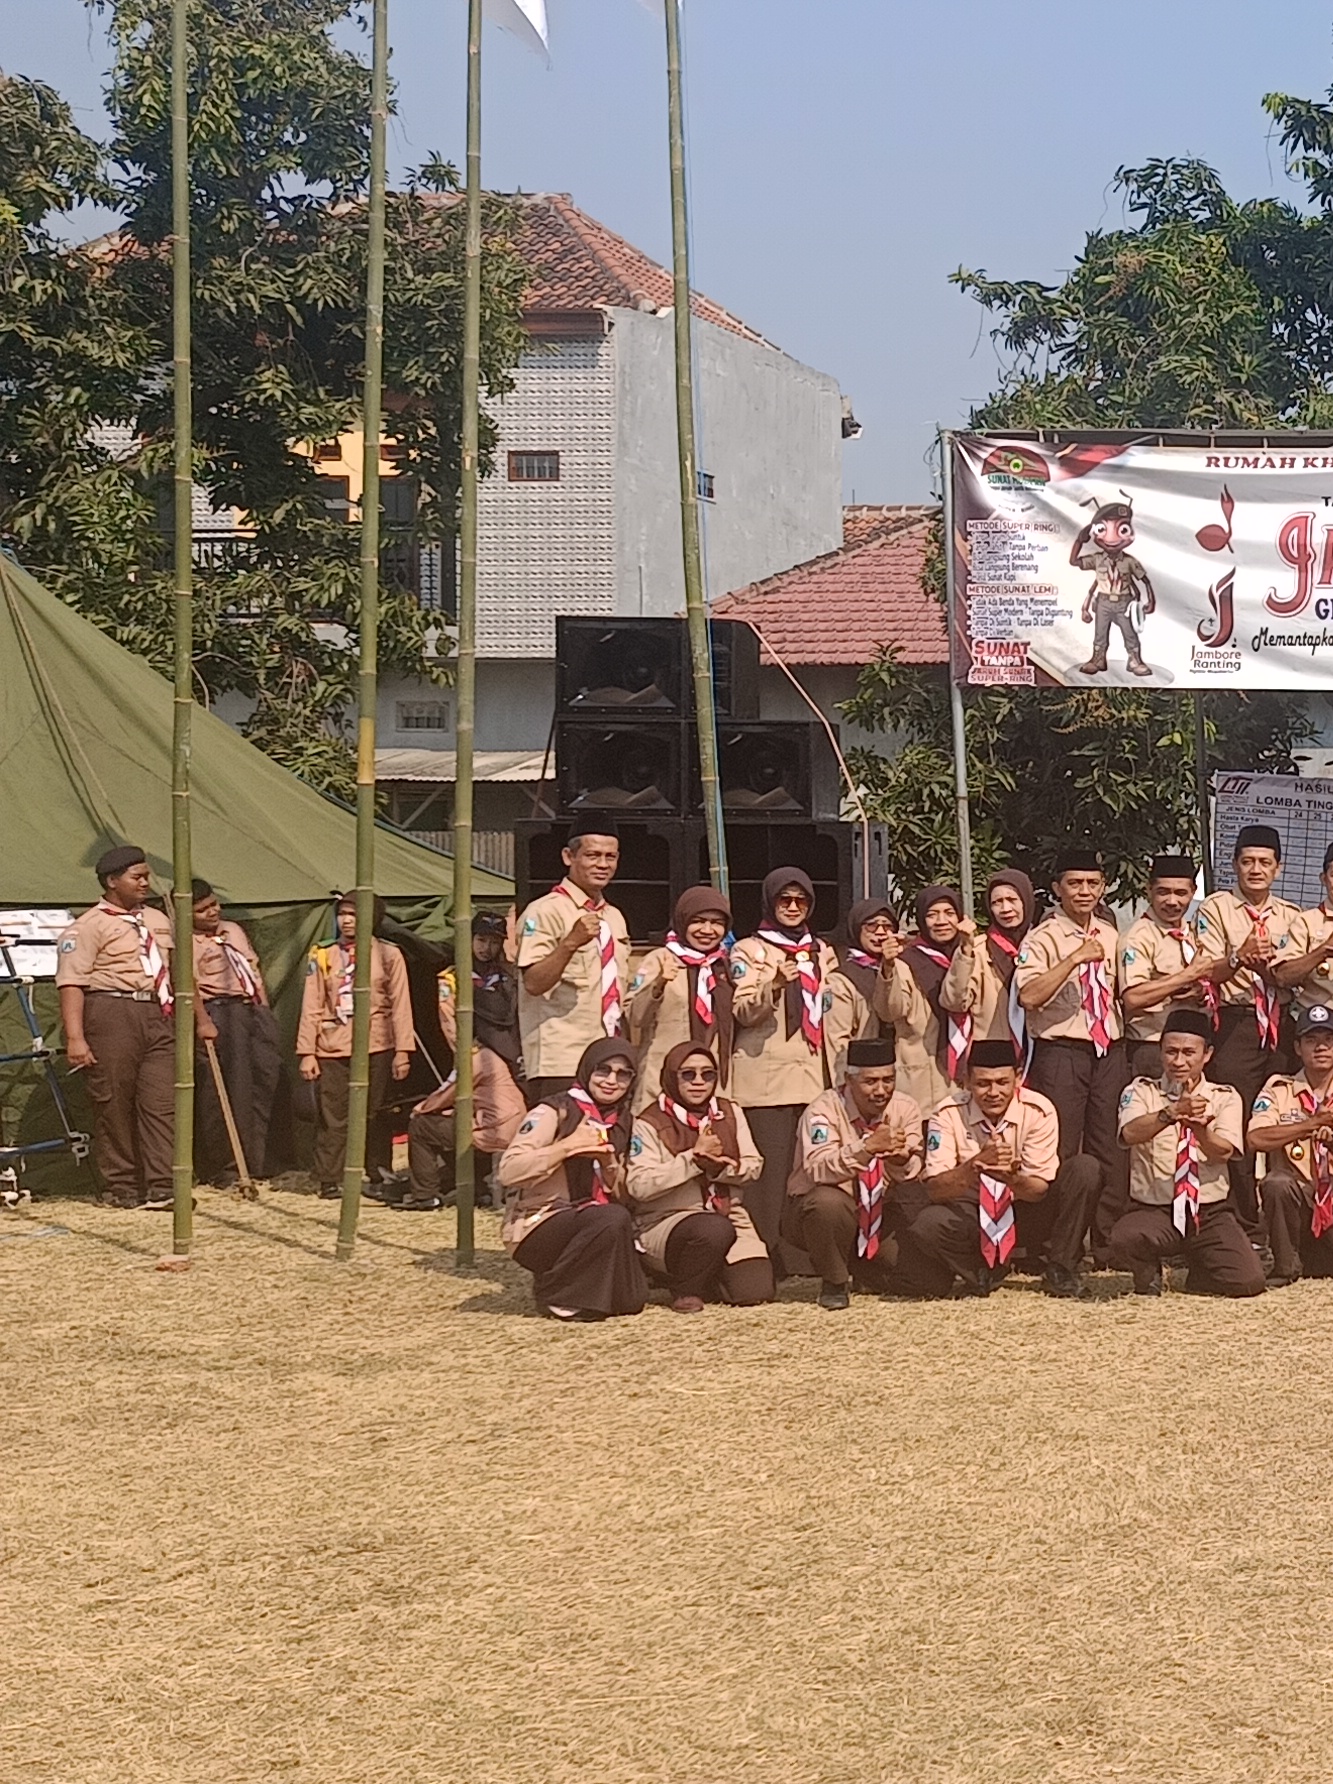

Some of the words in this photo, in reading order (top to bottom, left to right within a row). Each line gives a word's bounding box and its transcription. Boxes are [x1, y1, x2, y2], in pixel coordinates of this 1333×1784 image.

[1205, 455, 1296, 469] RUMAH
[974, 640, 1031, 656] SUNAT
[1191, 645, 1242, 661] Jambore
[983, 656, 1022, 667] TANPA
[1193, 660, 1242, 672] Ranting
[1256, 796, 1302, 808] LOMBA
